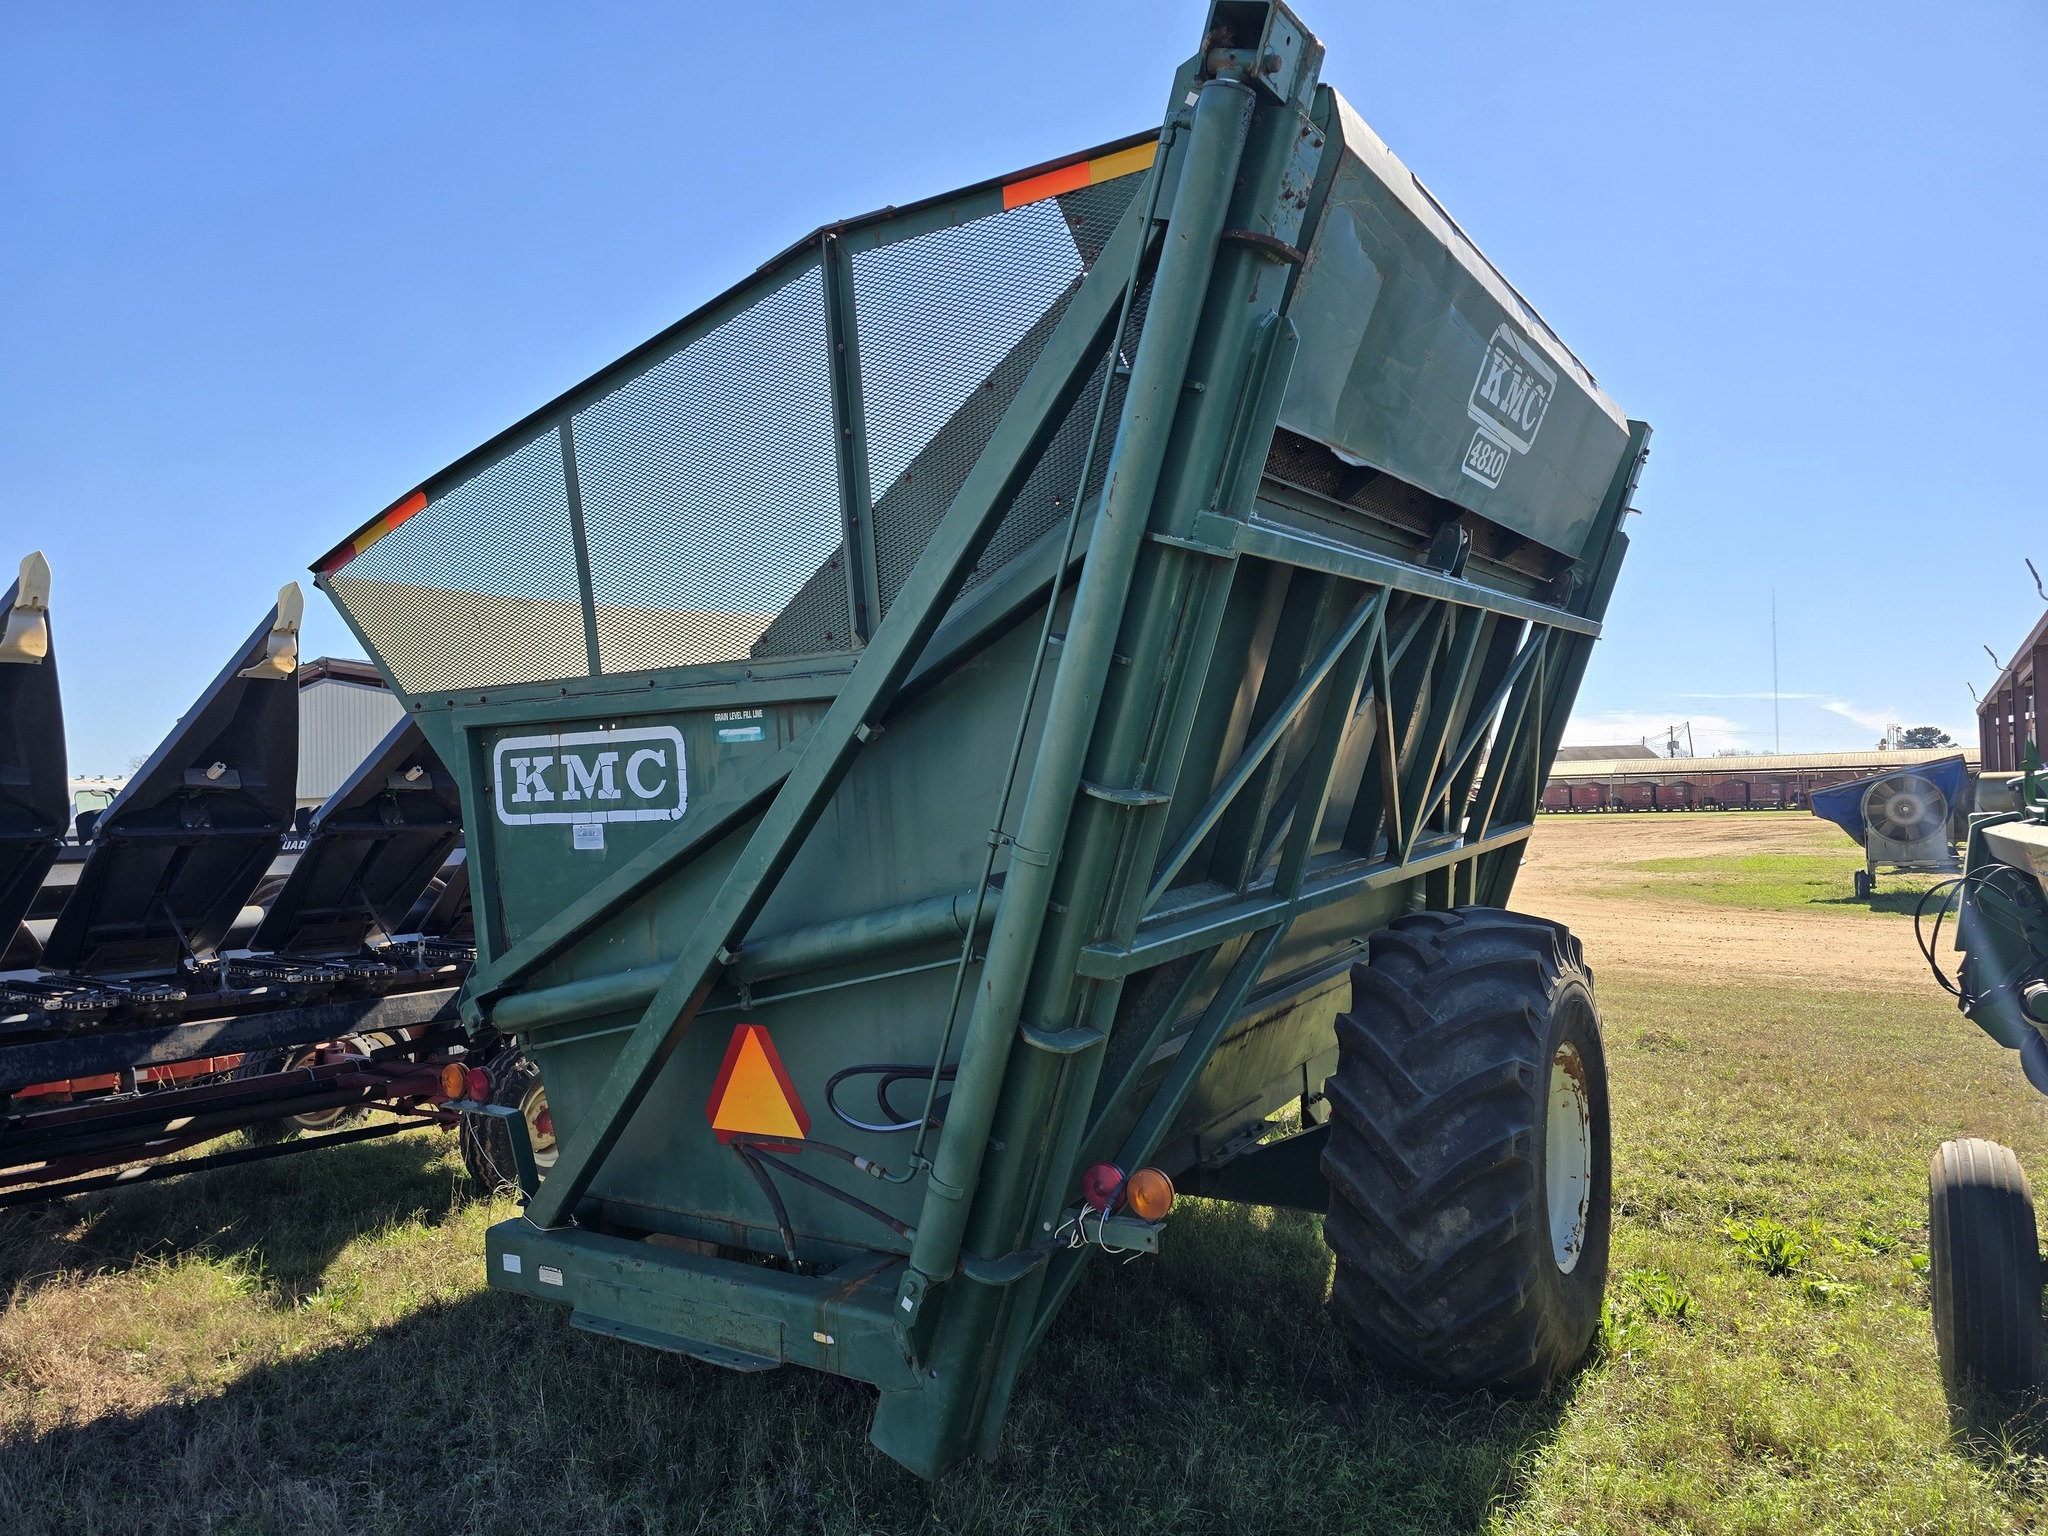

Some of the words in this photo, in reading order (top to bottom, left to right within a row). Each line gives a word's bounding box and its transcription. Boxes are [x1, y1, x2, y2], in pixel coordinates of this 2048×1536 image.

[1480, 347, 1547, 431] KMC
[1469, 440, 1505, 478] 4810
[714, 713, 729, 722] GRAIN
[729, 711, 743, 720] LEVEL
[743, 710, 752, 719] FILL
[752, 709, 763, 718] LINE
[510, 749, 667, 803] KMC
